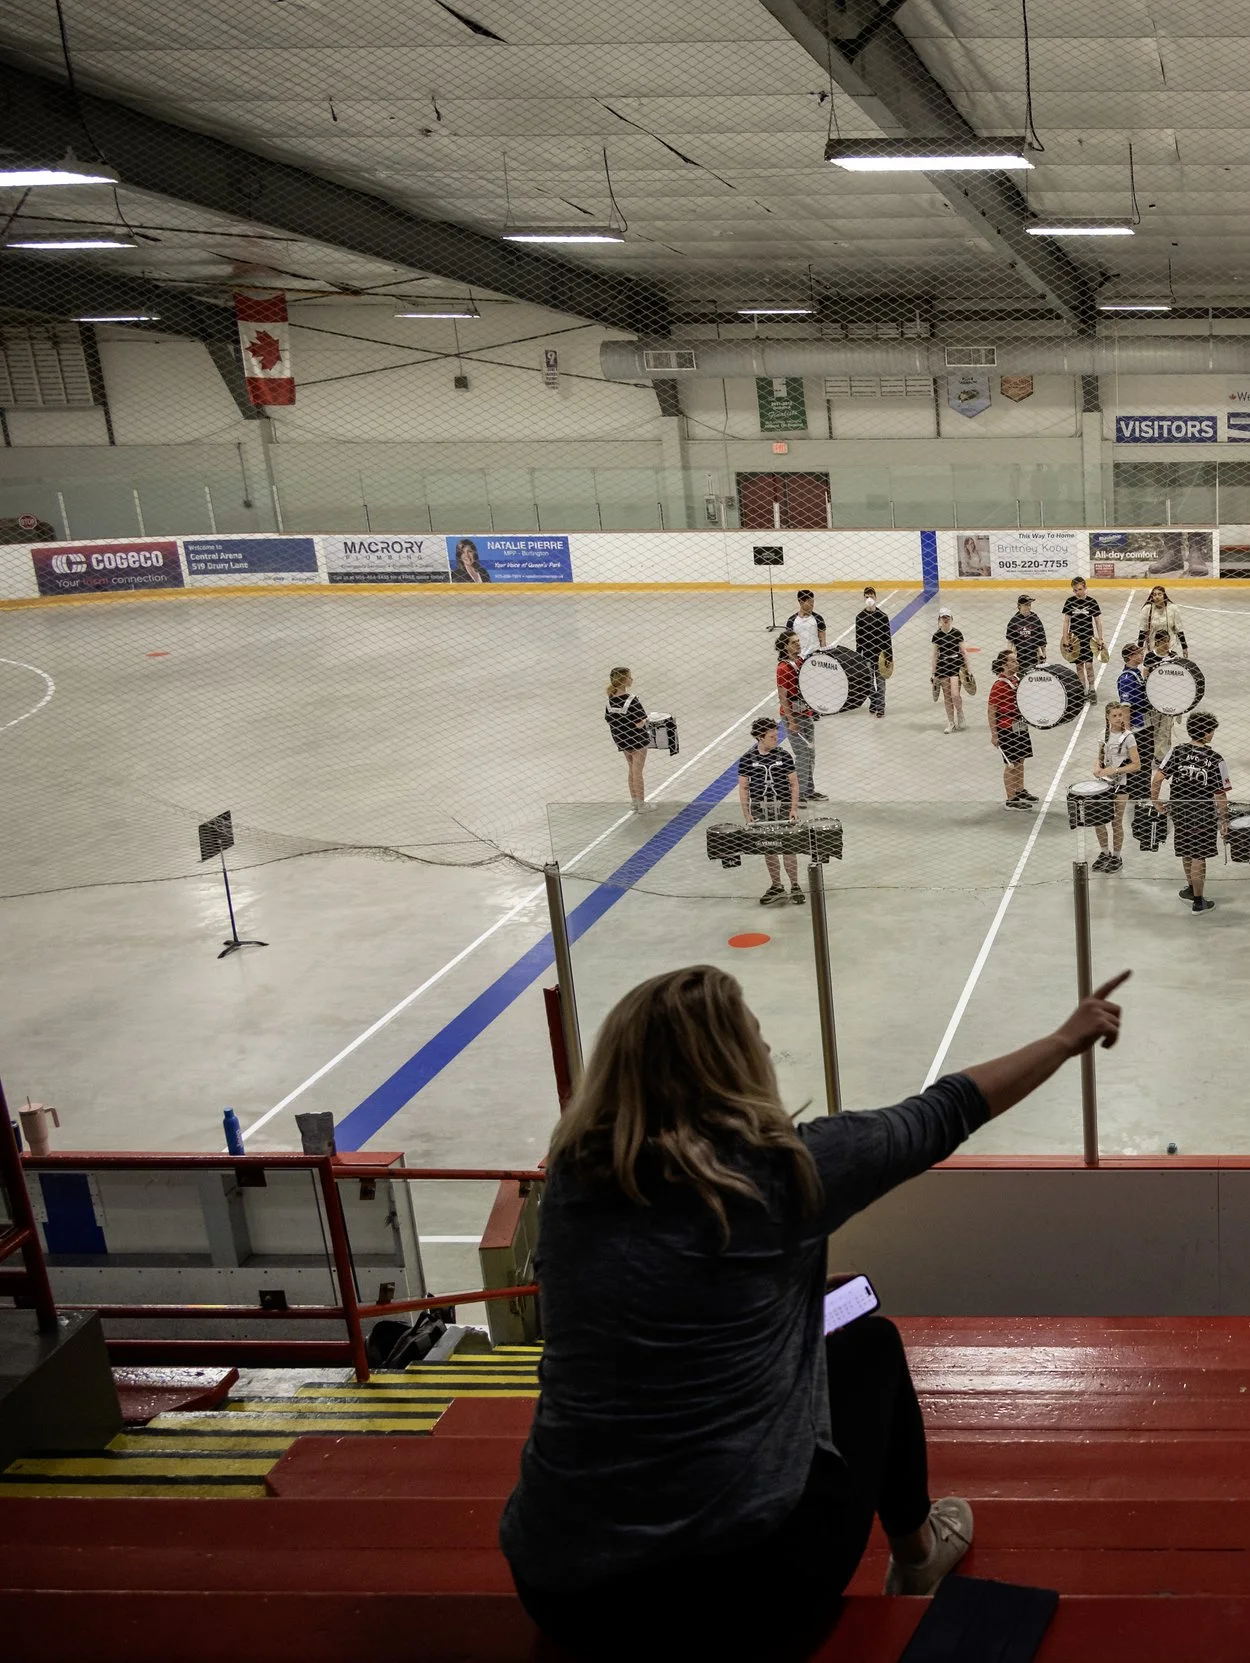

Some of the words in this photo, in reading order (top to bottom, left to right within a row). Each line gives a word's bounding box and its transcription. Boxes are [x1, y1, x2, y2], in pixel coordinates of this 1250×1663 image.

[1120, 420, 1214, 438] VISITORS
[344, 541, 423, 554] MACRORY
[997, 544, 1038, 554] Brittney
[1095, 551, 1125, 560] All-day
[998, 560, 1068, 568] 905-220-7755
[56, 579, 80, 588] Your
[112, 574, 168, 584] connection
[817, 661, 838, 670] YAMAHA
